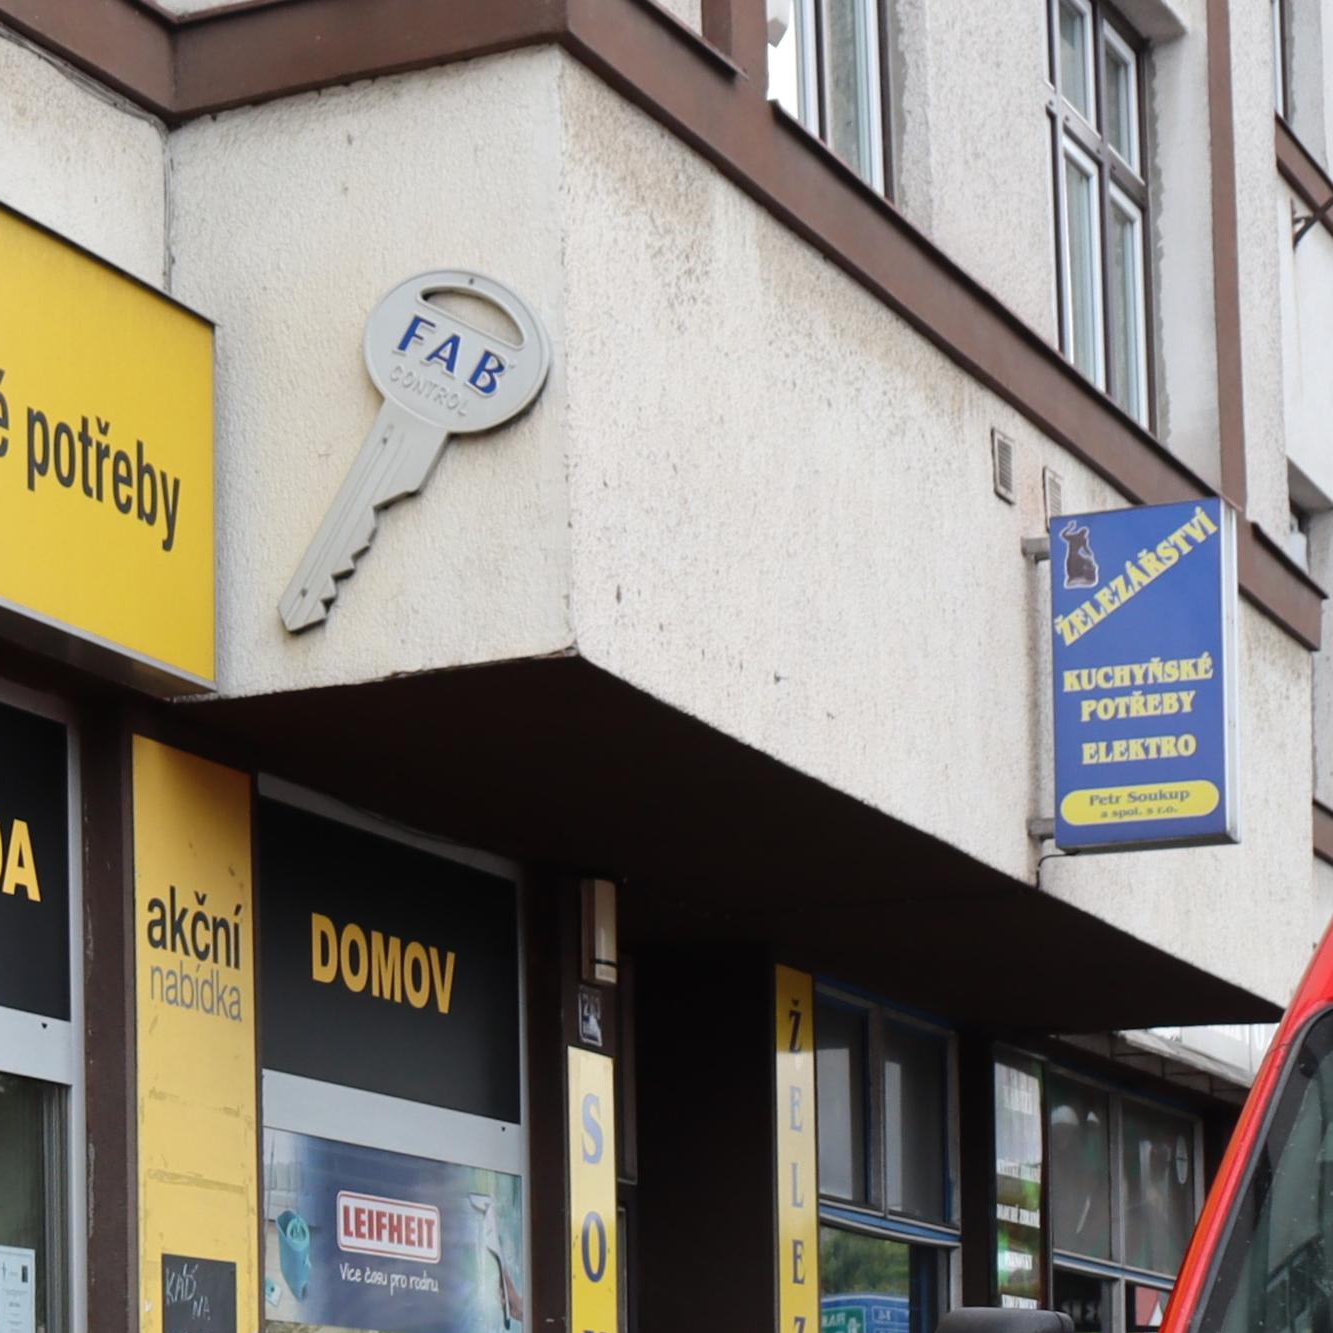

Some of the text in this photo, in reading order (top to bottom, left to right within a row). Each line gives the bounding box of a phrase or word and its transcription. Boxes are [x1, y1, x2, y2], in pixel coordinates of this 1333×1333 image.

[393, 315, 506, 396] FAB
[390, 365, 467, 416] CONTROL
[27, 406, 181, 551] potřeby
[1054, 506, 1219, 646] ŽELEZÁŘSTVÍ
[1063, 652, 1214, 692] KUCHYŇSKÉ
[1080, 689, 1196, 723] POTŘEBY
[1082, 734, 1197, 765] ELEKTRO
[1089, 789, 1190, 806] Petr Soukup
[147, 885, 241, 970] akční
[311, 912, 455, 1014] DOMOV
[150, 960, 242, 1023] nabídka
[343, 1205, 435, 1249] LEIFHEIT
[390, 1274, 407, 1296] pro
